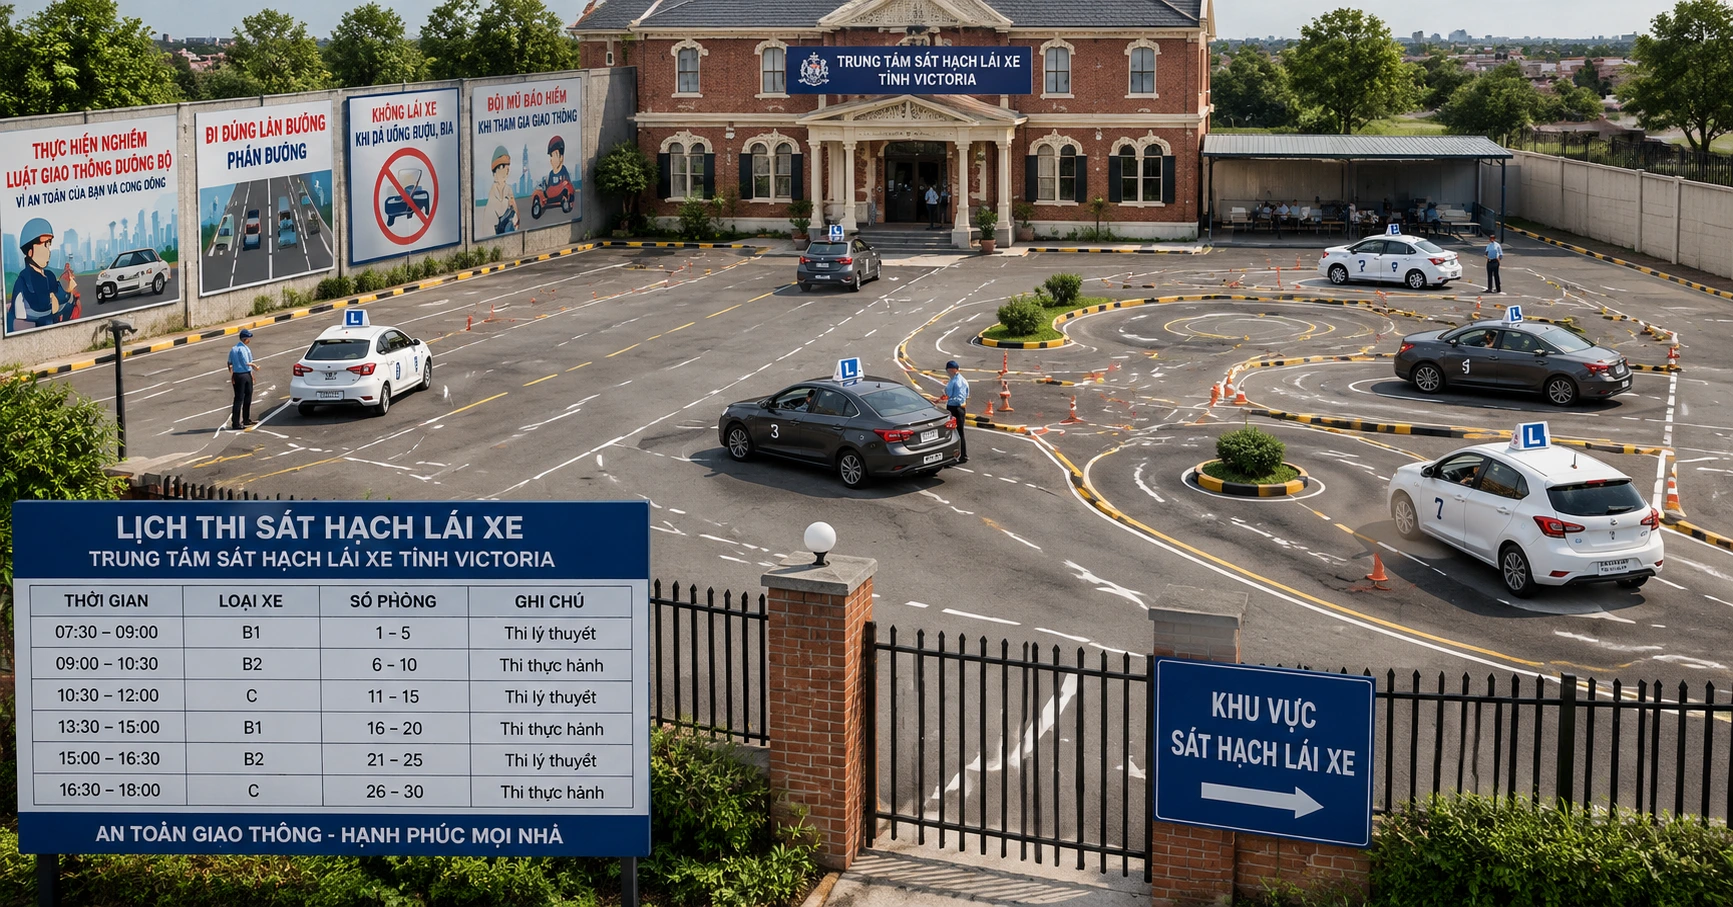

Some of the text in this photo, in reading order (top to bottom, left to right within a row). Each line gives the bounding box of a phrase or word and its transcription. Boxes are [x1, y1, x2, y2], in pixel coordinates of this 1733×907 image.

[837, 55, 881, 68] TRUNG
[943, 55, 977, 72] HẠCH
[1004, 55, 1021, 68] XE
[914, 73, 977, 86] VICTORIA
[425, 101, 437, 117] XE
[478, 120, 492, 135] KHI
[493, 117, 516, 133] THAM
[517, 116, 531, 130] GIA
[532, 112, 551, 128] GIAO
[355, 131, 370, 147] KHI
[440, 121, 454, 136] BIA
[41, 165, 70, 184] GIAO
[28, 193, 41, 207] AN
[845, 362, 854, 376] L
[770, 424, 779, 439] 3
[1528, 427, 1540, 445] L
[1434, 497, 1444, 520] 7
[117, 509, 523, 545] LỊCH THI SÁT HẠCH LÁI XE
[89, 550, 160, 568] TRUNG
[217, 546, 256, 568] SÁT
[262, 550, 321, 572] HẠCH
[328, 546, 360, 568] LÁI
[365, 550, 393, 568] XE
[454, 550, 556, 568] VICTORIA
[109, 593, 149, 608] GIAN
[219, 593, 284, 612] LOẠI XE
[515, 592, 585, 609] GHI CHÚ
[55, 625, 97, 639] 07:30
[115, 625, 158, 639] 09:00
[243, 625, 260, 639] B1
[375, 626, 383, 640] 1
[401, 626, 411, 640] 5
[504, 625, 528, 640] Thi
[532, 625, 545, 644] lý
[56, 656, 98, 670] 09:00
[117, 657, 159, 671] 10:30
[243, 657, 262, 671] B2
[372, 657, 382, 672] 6
[400, 657, 418, 672] 10
[499, 657, 523, 672] Thi
[528, 658, 562, 675] thực
[57, 688, 99, 702] 10:30
[117, 688, 159, 702] 12:00
[246, 689, 258, 703] C
[368, 689, 383, 703] 11
[402, 689, 420, 703] 15
[504, 689, 528, 704] Thi
[533, 689, 546, 707] lý
[1212, 691, 1317, 733] KHU VỰC
[58, 719, 100, 734] 13:30
[118, 720, 160, 734] 15:00
[244, 720, 262, 735] B1
[367, 721, 385, 735] 16
[402, 721, 423, 736] 20
[500, 721, 524, 736] Thi
[528, 721, 563, 738] thực
[59, 751, 100, 765] 15:00
[118, 751, 161, 766] 16:30
[244, 752, 264, 766] B2
[1171, 726, 1356, 777] SÁT HẠCH LÁI XE
[367, 752, 384, 767] 21
[403, 753, 423, 768] 25
[504, 752, 528, 767] Thi
[533, 752, 546, 771] lý
[59, 782, 101, 797] 16:30
[119, 783, 161, 797] 18:00
[248, 783, 260, 798] C
[366, 784, 386, 799] 26
[404, 784, 424, 799] 30
[500, 784, 524, 799] Thi
[528, 785, 563, 802] thực
[95, 825, 125, 842] AN
[192, 826, 243, 843] GIAO
[249, 822, 322, 843] THÔNG
[341, 827, 400, 848] HẠNH
[407, 823, 466, 844] PHÚC
[472, 827, 511, 848] MỌI
